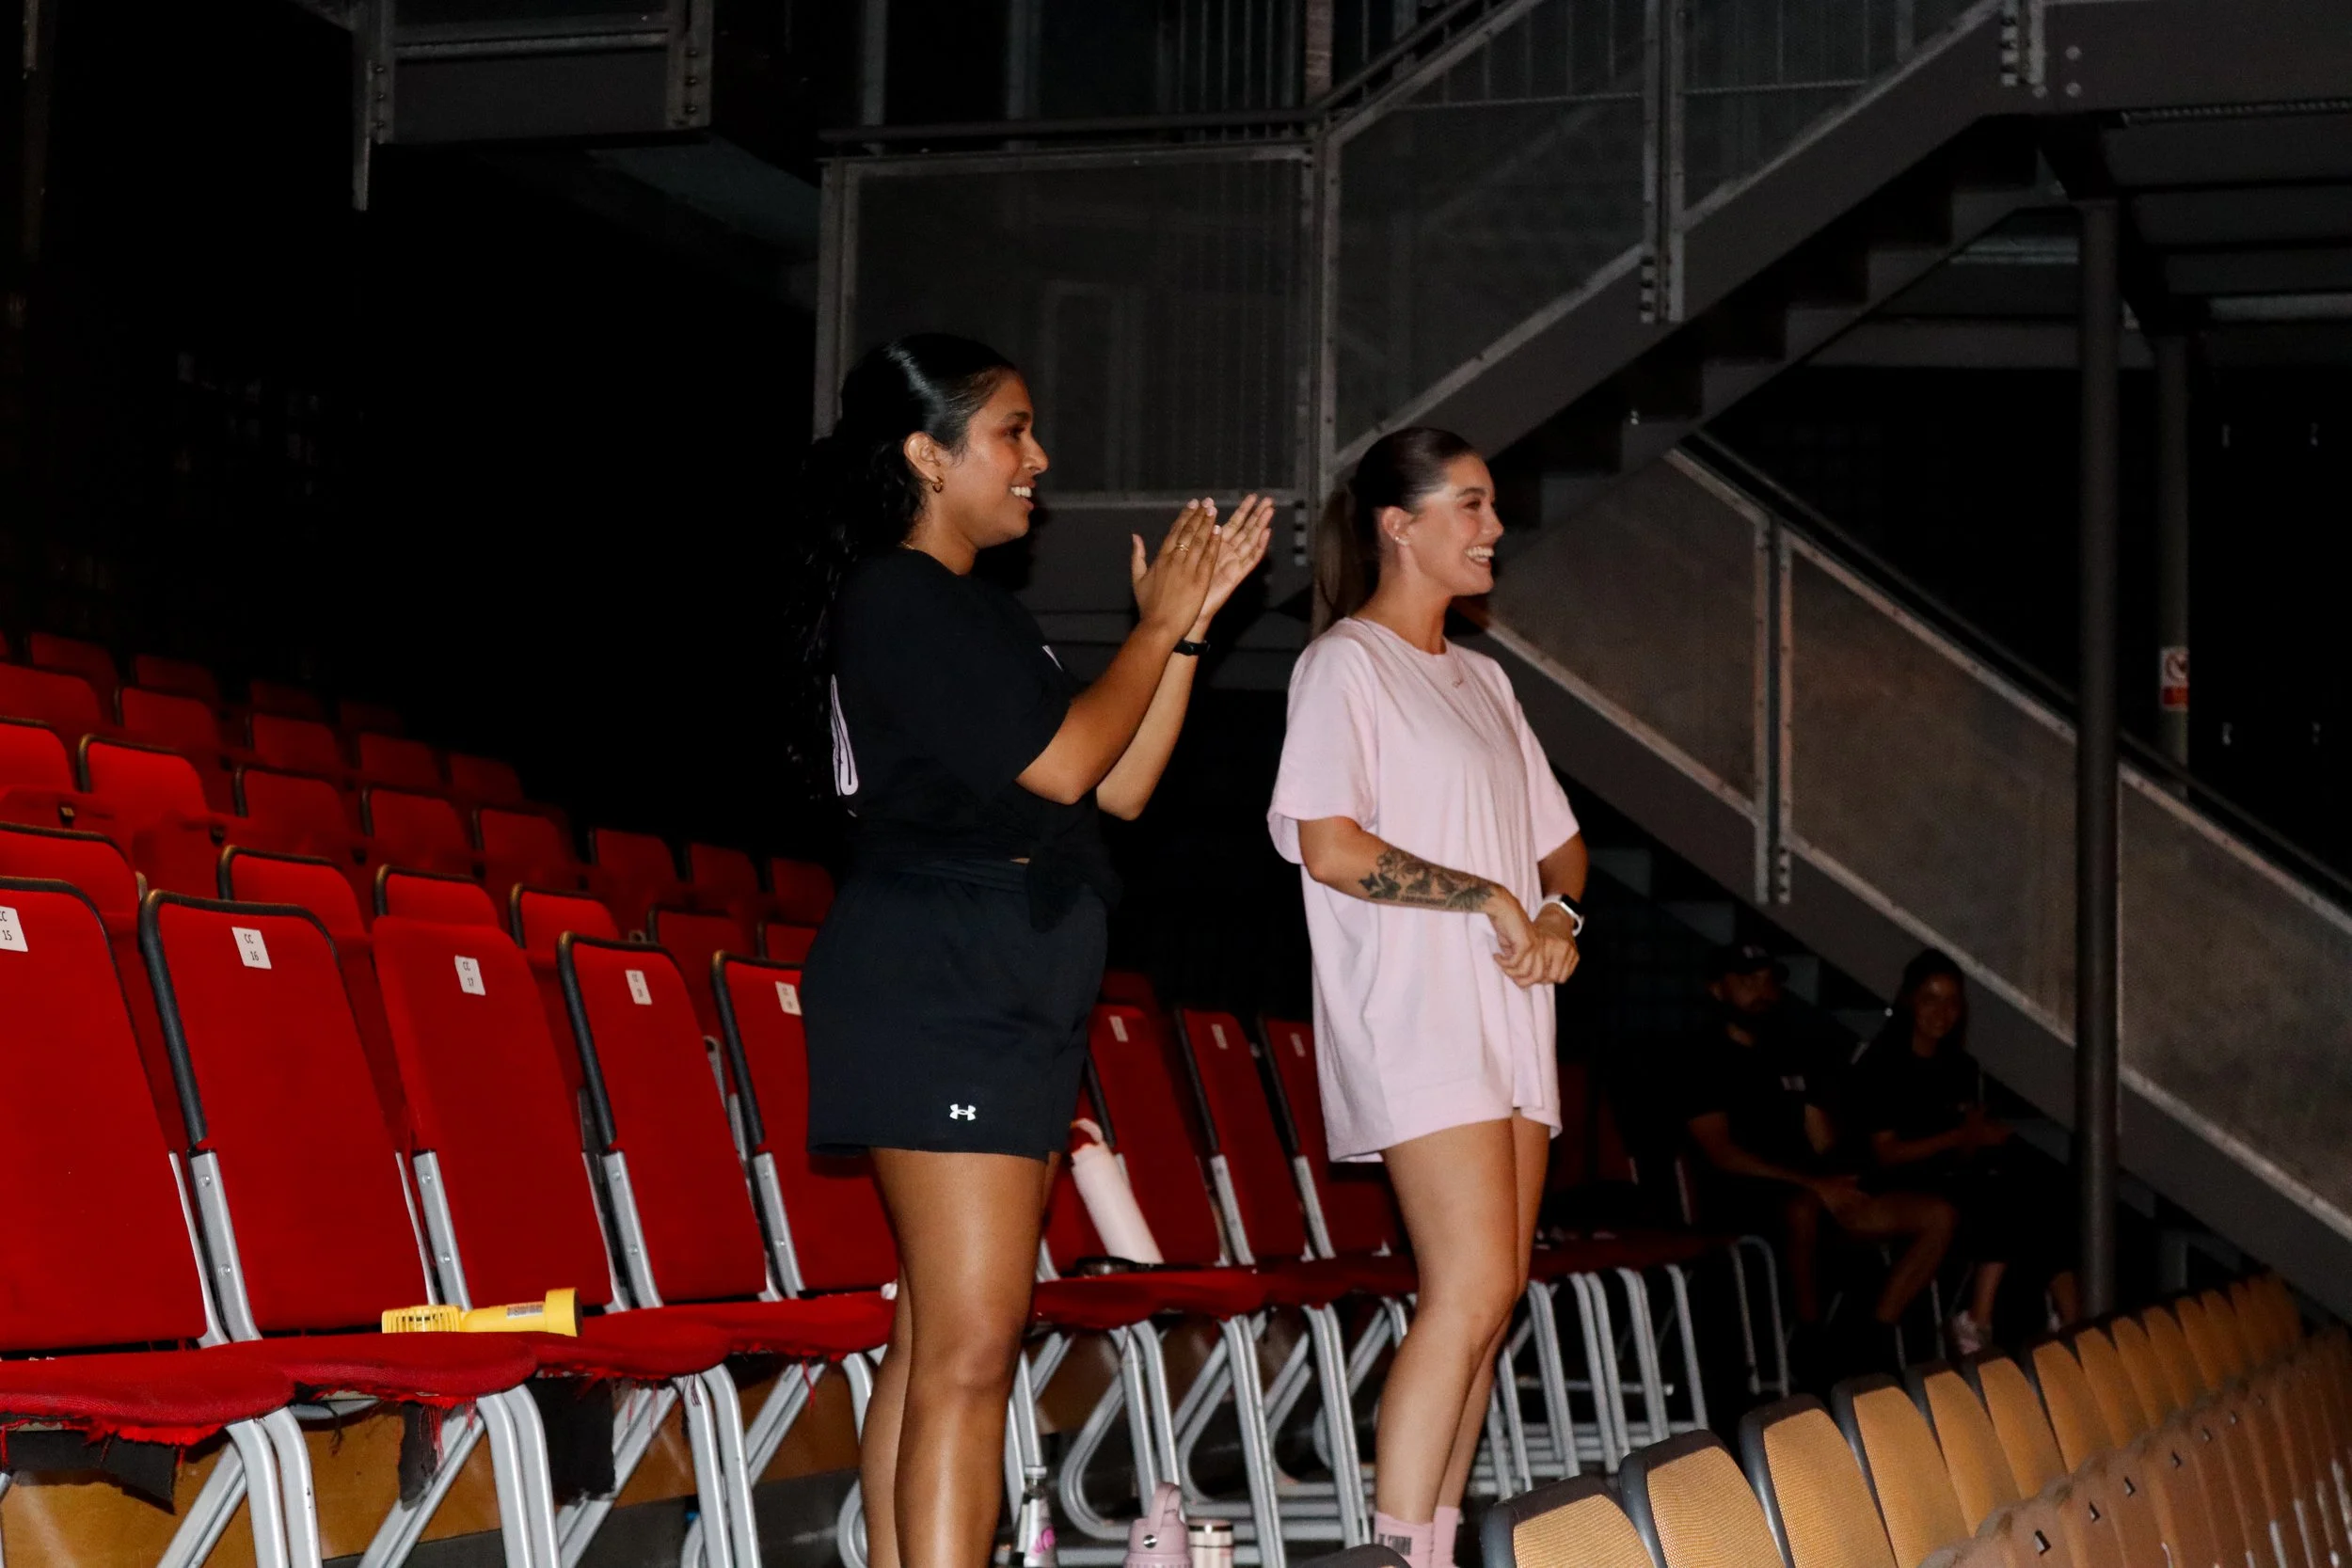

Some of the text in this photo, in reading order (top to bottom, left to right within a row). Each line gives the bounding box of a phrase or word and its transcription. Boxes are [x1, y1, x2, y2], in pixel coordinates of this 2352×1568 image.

[2, 929, 13, 942] 15
[244, 933, 254, 944] CC
[250, 950, 260, 961] 16
[462, 961, 471, 972] CC
[467, 977, 474, 987] 17
